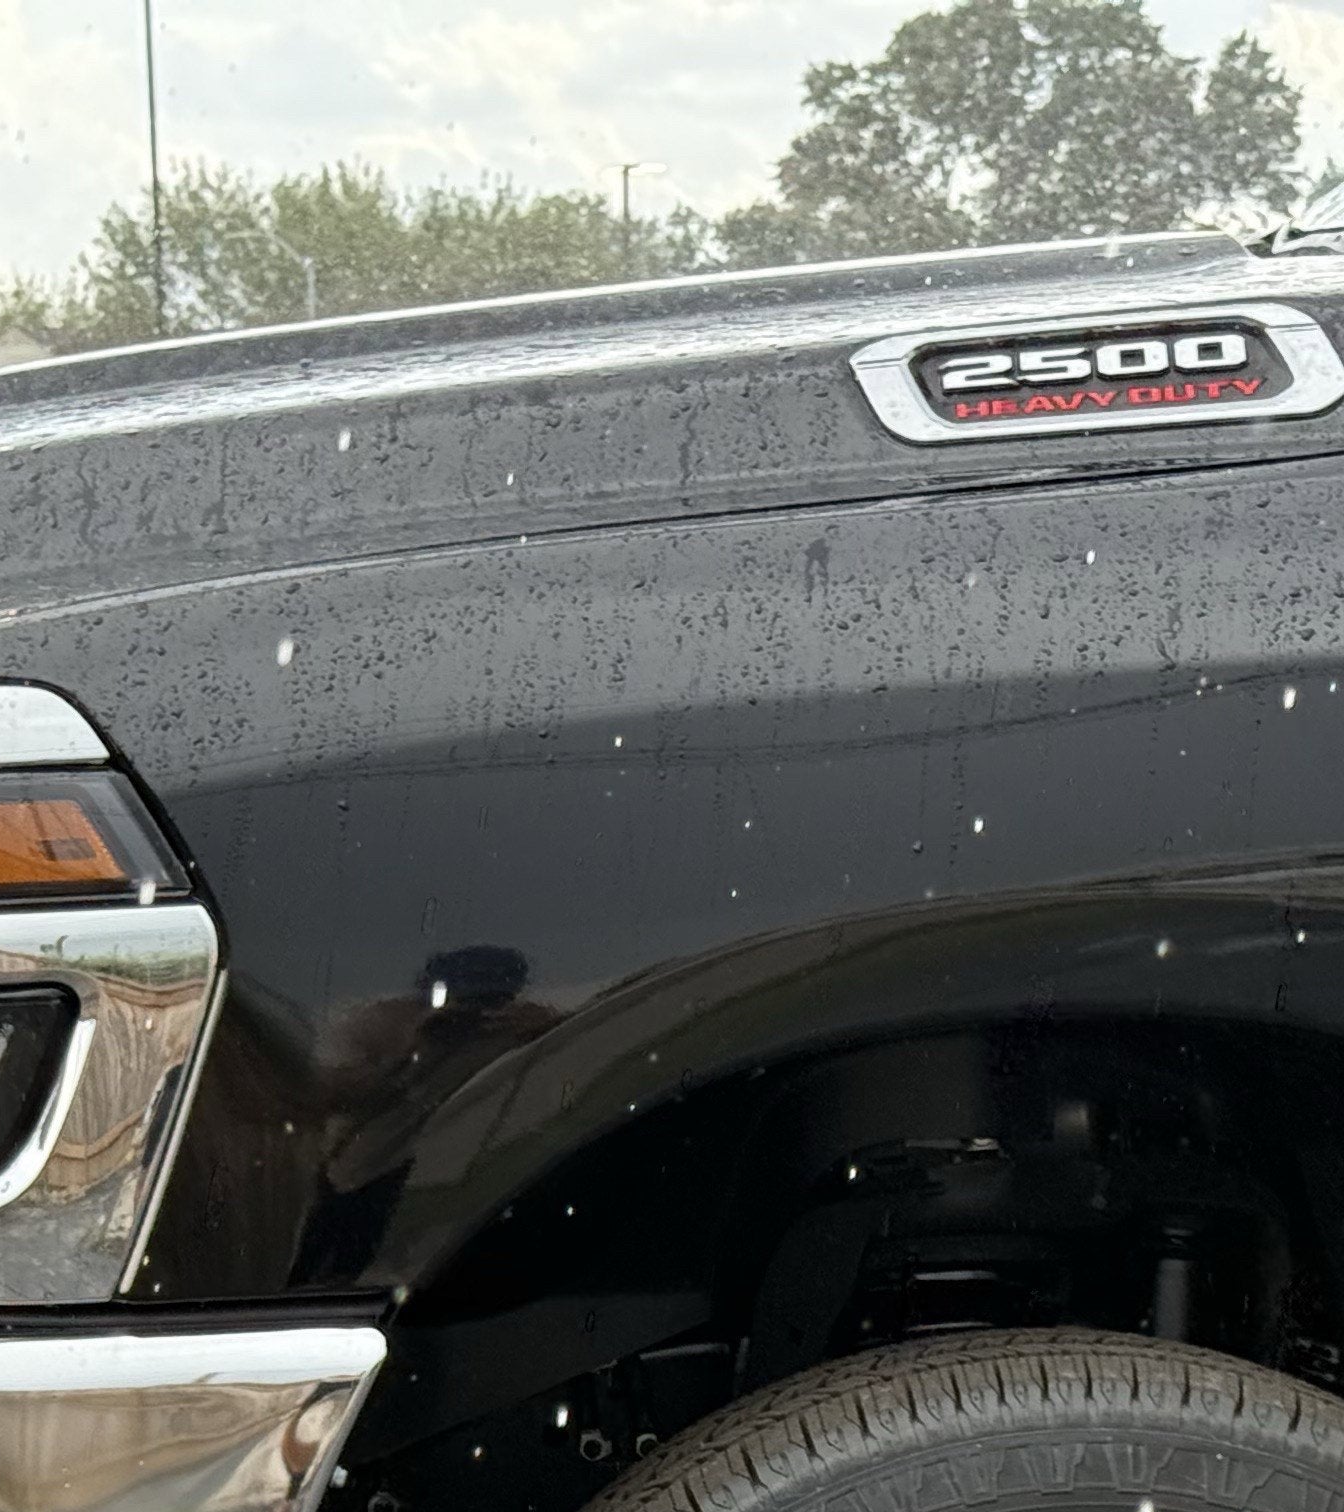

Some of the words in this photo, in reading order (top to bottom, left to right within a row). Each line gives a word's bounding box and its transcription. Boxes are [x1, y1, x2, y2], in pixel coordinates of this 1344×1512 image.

[940, 334, 1248, 390] 2500
[955, 386, 1115, 419] HEAVY
[1128, 379, 1264, 404] DUTY
